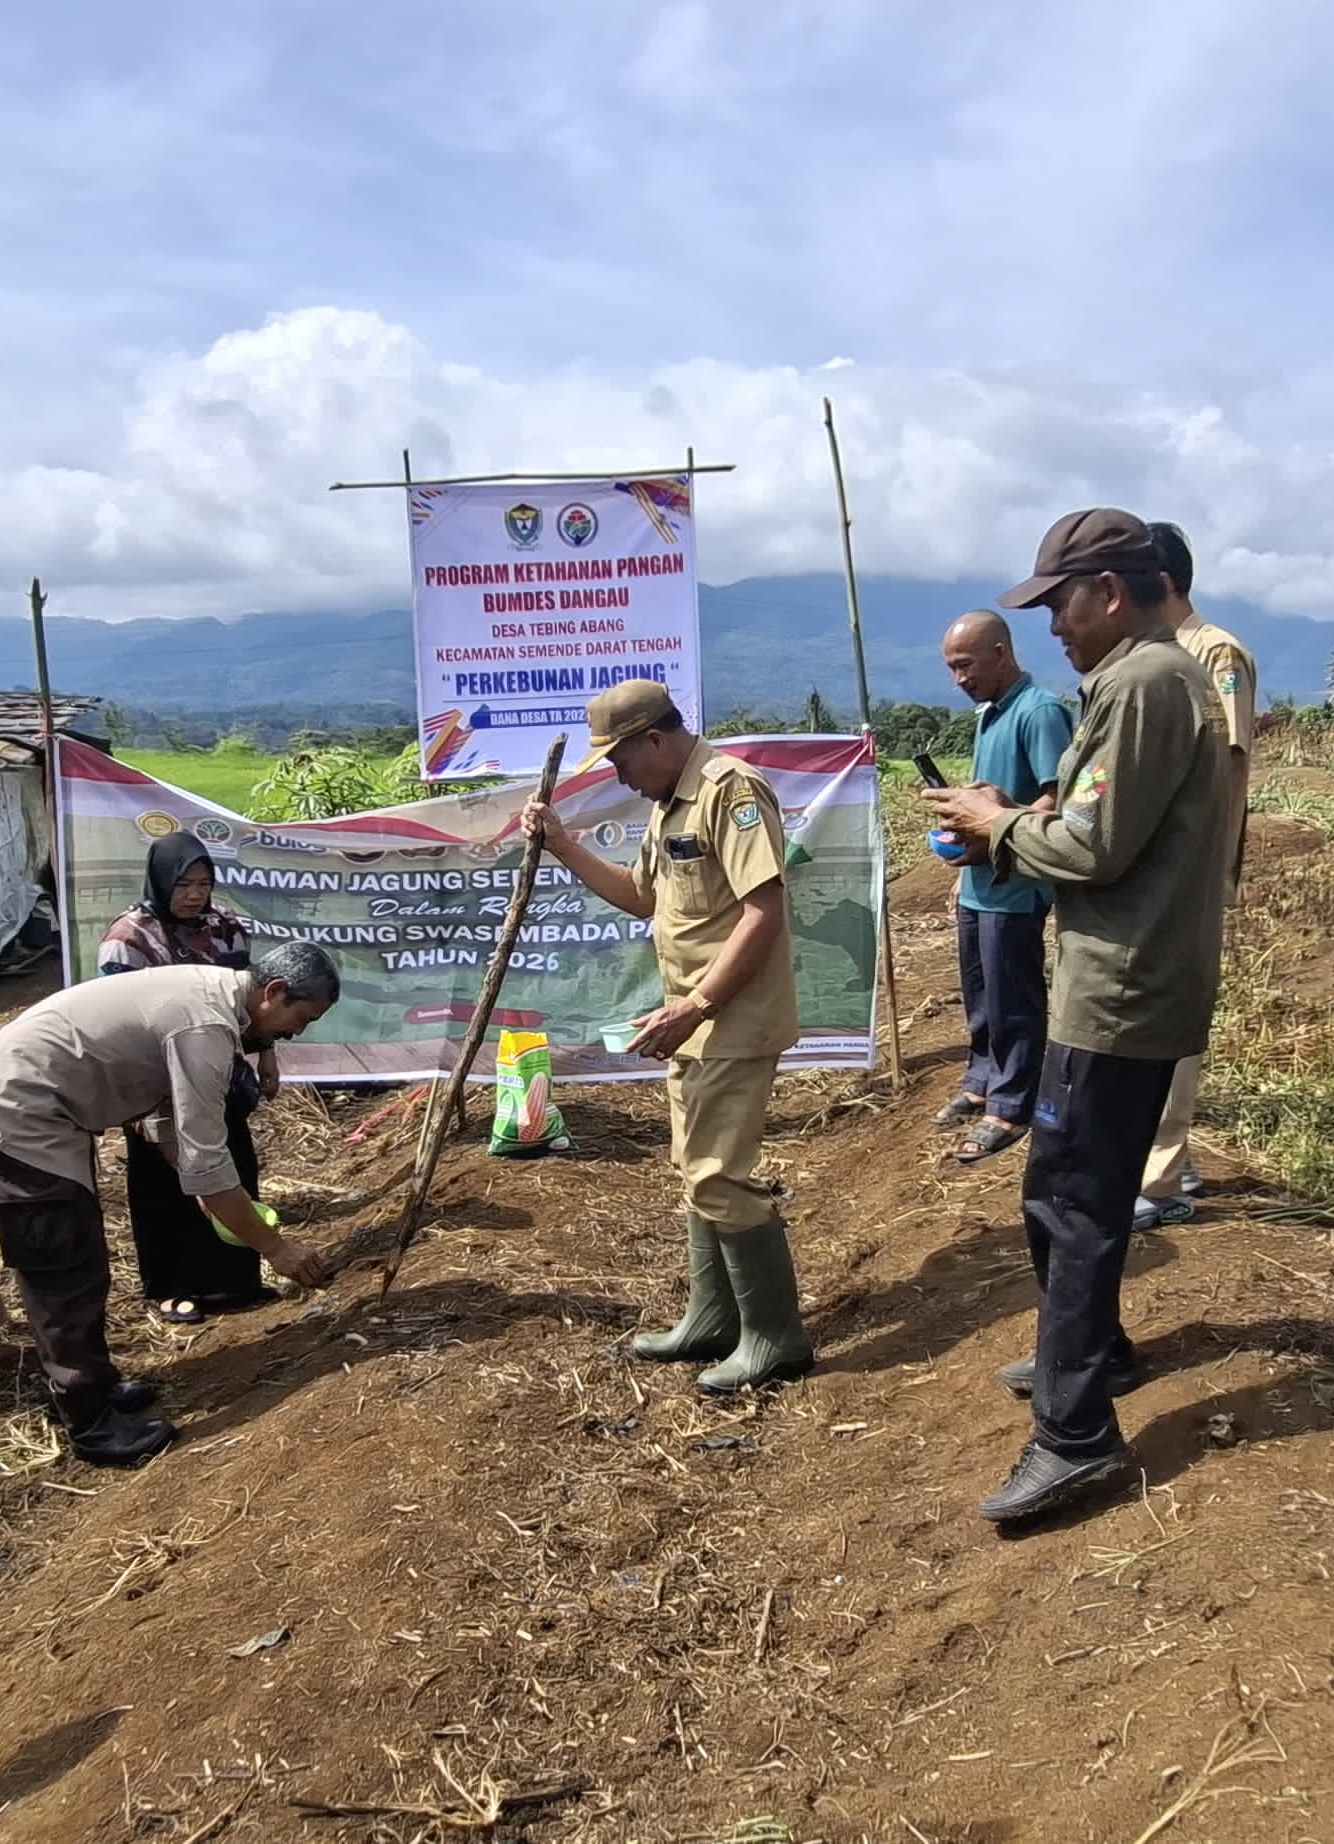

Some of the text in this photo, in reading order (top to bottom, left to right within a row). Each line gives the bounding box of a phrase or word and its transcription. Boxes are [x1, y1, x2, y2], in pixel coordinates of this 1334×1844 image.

[425, 553, 684, 587] PROGRAM KETAHANAN PANGAN
[483, 587, 629, 613] BUMDES DANGAU
[492, 618, 624, 638] DESA TEBING ABANG
[436, 637, 682, 662] KECAMATAN SEMENDE DARAT TENGAH
[455, 671, 584, 696] PERKEBUNAN
[589, 663, 666, 690] JAGUNG
[491, 709, 588, 726] DANA DESA TA 202
[348, 871, 463, 891] JAGUNG
[370, 898, 466, 916] Dalam
[237, 916, 397, 943] ENDUKUNG
[381, 948, 477, 969] TAHUN
